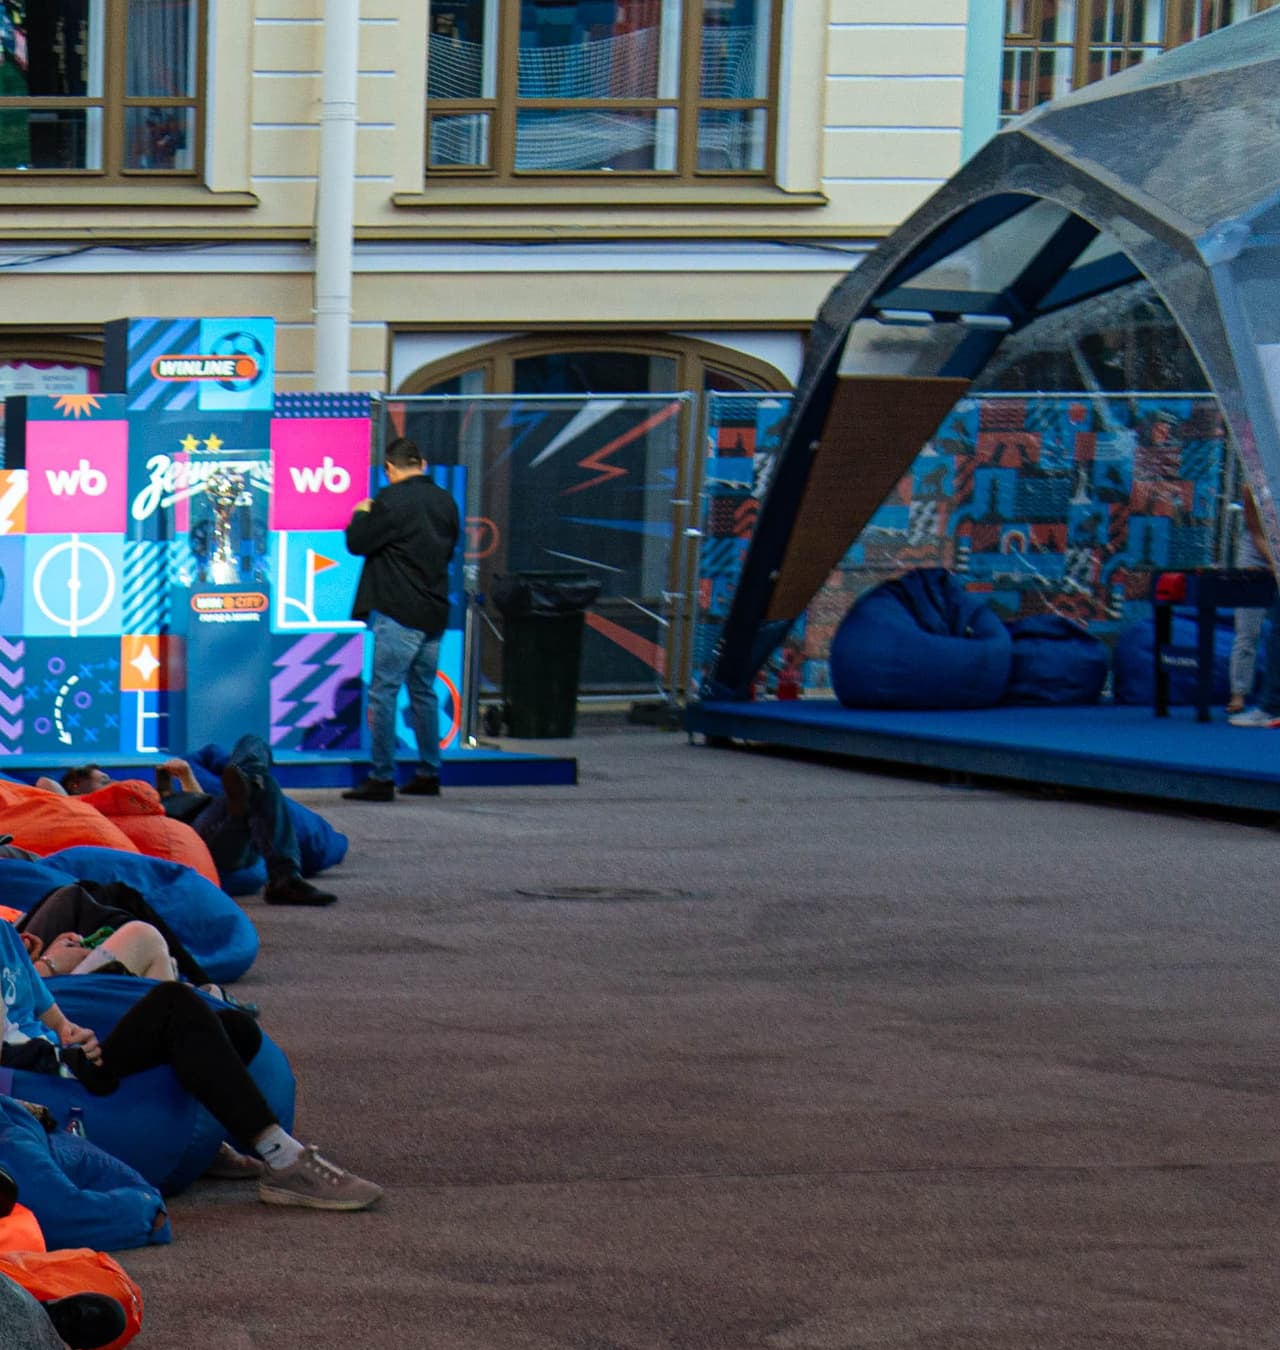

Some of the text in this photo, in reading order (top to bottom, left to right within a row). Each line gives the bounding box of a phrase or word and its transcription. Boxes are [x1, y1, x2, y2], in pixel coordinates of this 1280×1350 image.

[159, 360, 235, 376] WINLINE
[44, 459, 108, 497] wb
[132, 455, 272, 520] Зени
[290, 456, 351, 493] wb
